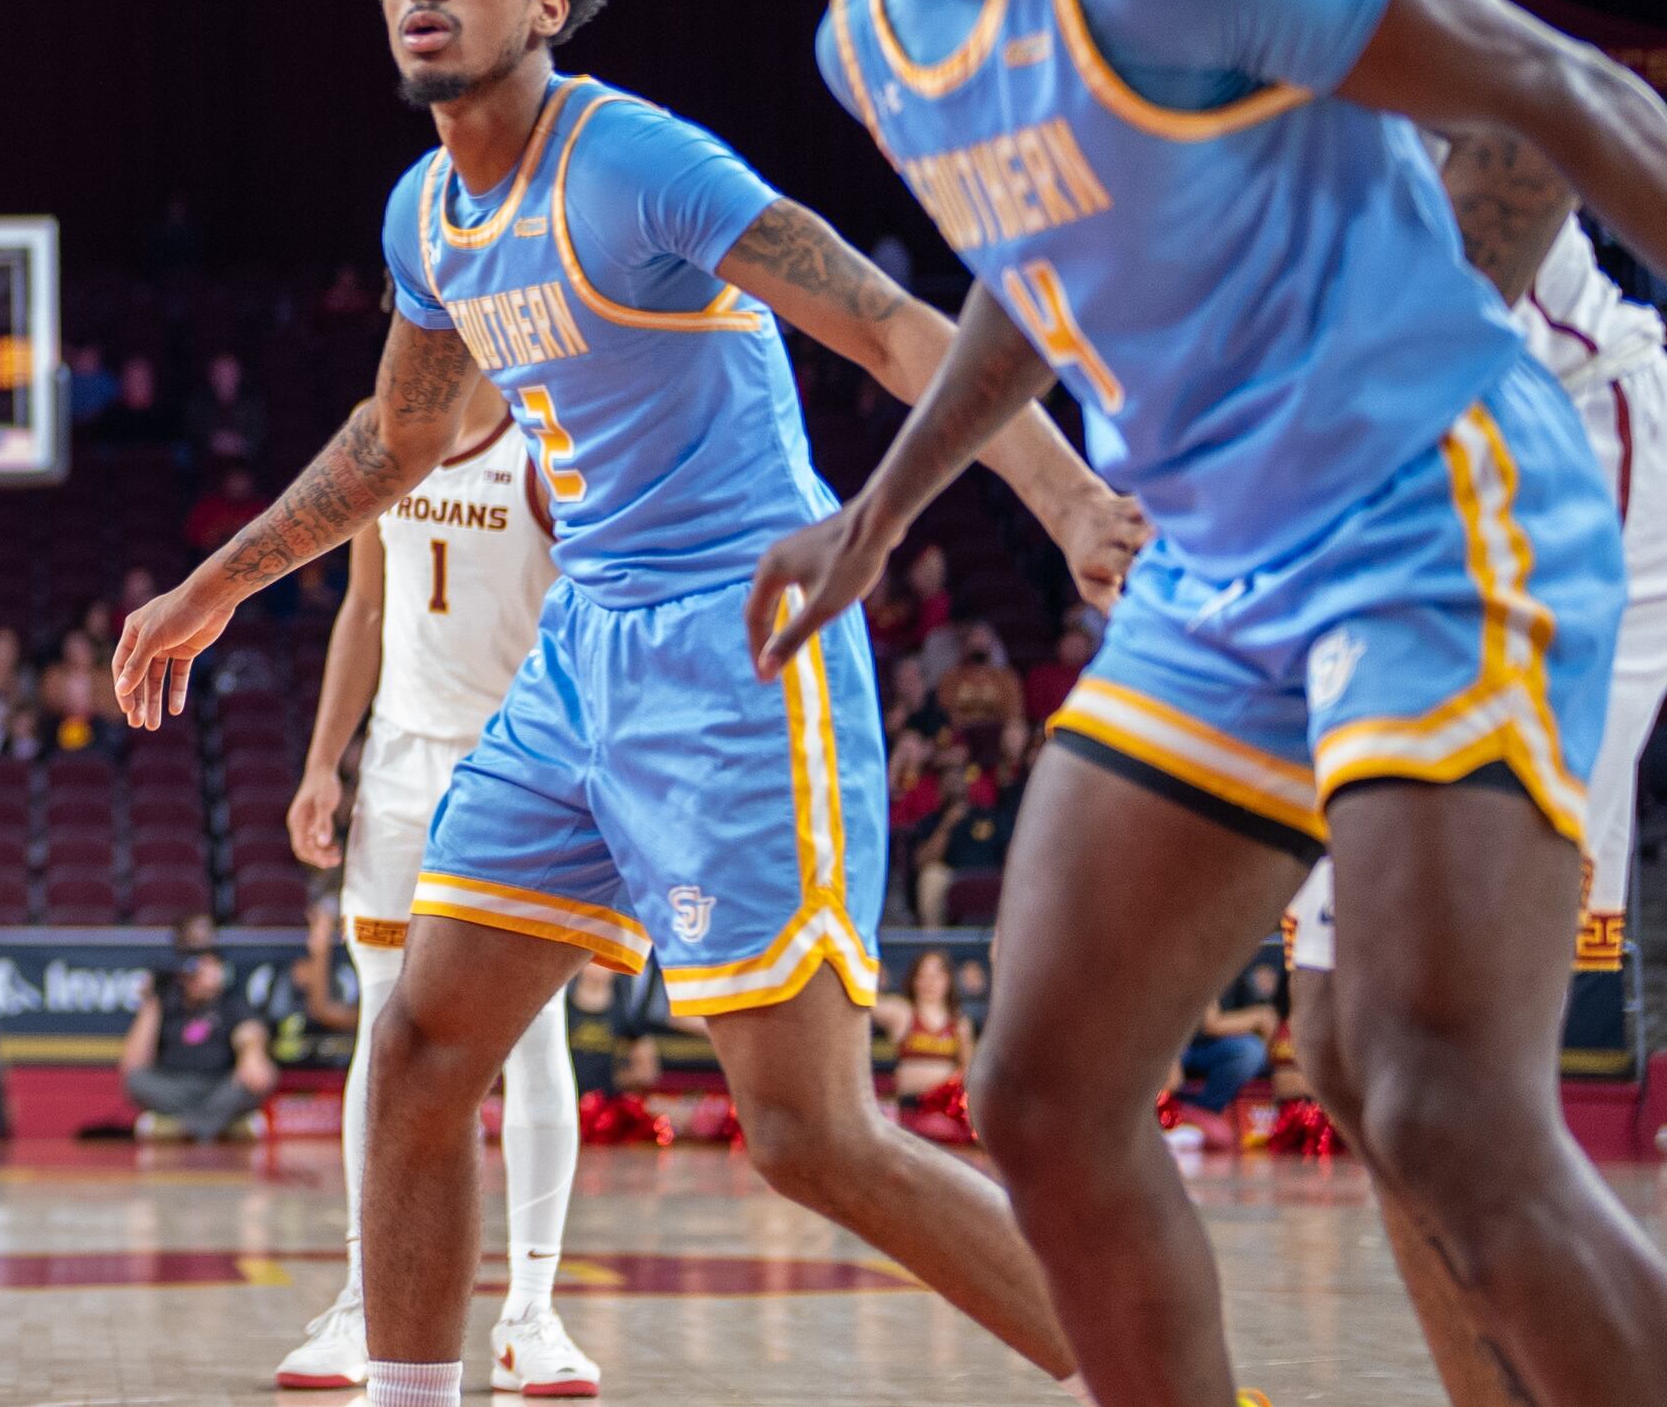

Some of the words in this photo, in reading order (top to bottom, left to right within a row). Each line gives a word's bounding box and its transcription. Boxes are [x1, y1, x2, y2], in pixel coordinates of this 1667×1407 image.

[1001, 257, 1126, 415] 4
[517, 384, 588, 503] 2
[387, 496, 509, 532] ROJANS
[428, 536, 450, 615] 1
